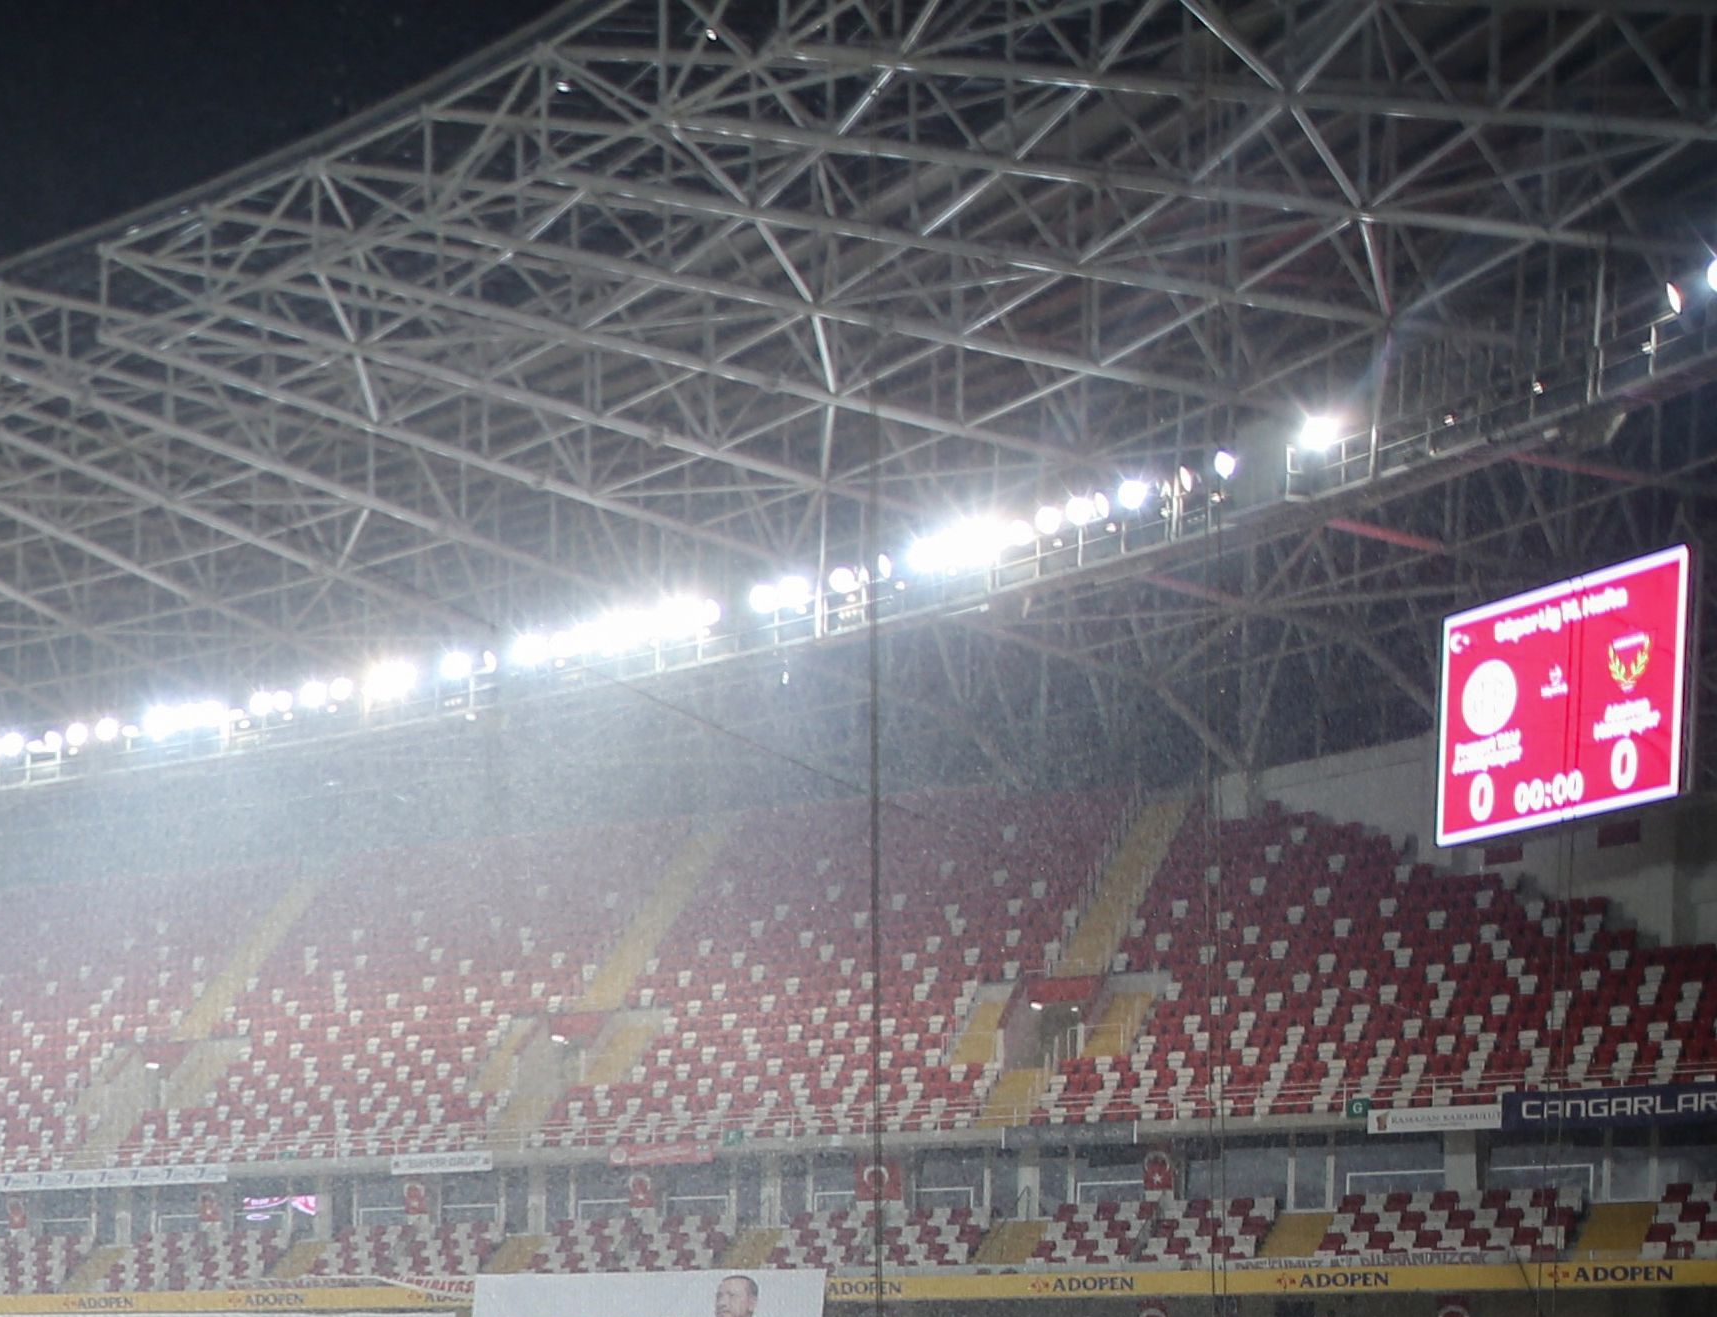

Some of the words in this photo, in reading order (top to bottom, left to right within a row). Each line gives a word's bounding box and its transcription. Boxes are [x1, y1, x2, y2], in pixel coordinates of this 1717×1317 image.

[1611, 738, 1638, 790] 0
[1469, 772, 1495, 822] 0
[1515, 769, 1584, 814] 00:00
[1299, 1271, 1389, 1289] ADOPEN
[1574, 1265, 1673, 1283] ADOPEN
[827, 1280, 902, 1296] ADOPEN
[1053, 1277, 1134, 1292] ADOPEN
[77, 1296, 134, 1309] ADOPEN
[245, 1294, 305, 1307] ADOPEN
